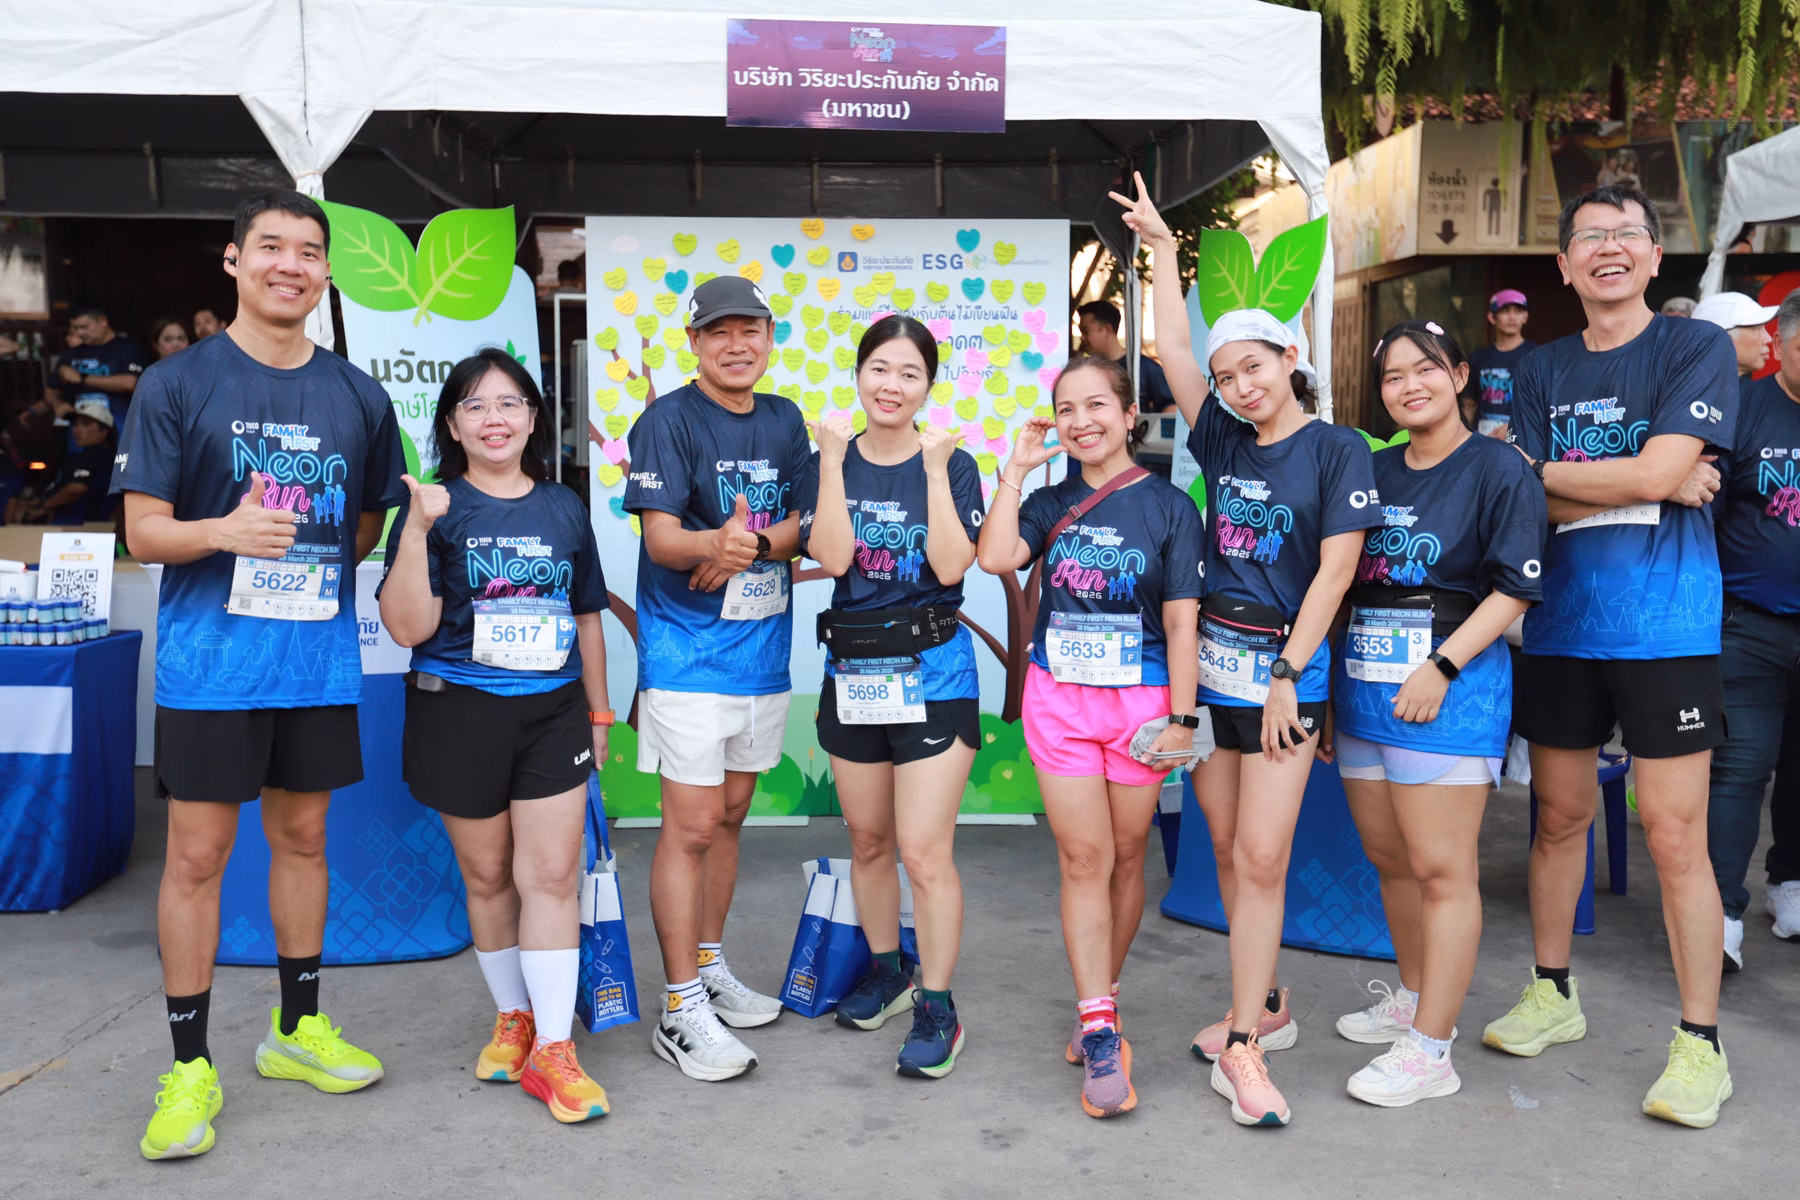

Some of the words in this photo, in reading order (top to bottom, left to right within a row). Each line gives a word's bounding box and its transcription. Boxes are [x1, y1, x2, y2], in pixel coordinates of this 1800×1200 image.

[733, 66, 792, 87] บริษัท
[798, 68, 940, 91] วิริยะประกันภัย
[946, 71, 1000, 92] จำกัด
[822, 98, 910, 120] (มหาชน)
[922, 254, 963, 270] ESG
[281, 437, 321, 451] FIRST
[1216, 514, 1257, 554] Run
[1049, 535, 1145, 574] Neon
[1226, 548, 1250, 559] 2026
[467, 549, 573, 589] Neon
[867, 571, 891, 581] 2026
[252, 571, 307, 591] 5622
[1051, 558, 1106, 596] Run
[324, 588, 333, 597] M
[741, 578, 776, 598] 5629
[1076, 590, 1102, 600] 2026
[538, 598, 555, 606] NEON
[491, 625, 541, 643] 5617
[1223, 629, 1238, 639] FIRST
[1239, 635, 1258, 643] NEON
[563, 639, 569, 647] F
[1060, 640, 1106, 659] 5633
[1353, 635, 1393, 656] 3553
[1128, 654, 1134, 662] F
[1199, 645, 1239, 673] 5643
[1417, 651, 1422, 659] F
[848, 684, 889, 700] 5698
[910, 694, 916, 702] F
[598, 999, 623, 1009] PLASTIC
[598, 1005, 624, 1016] BOTTLES
[169, 1010, 197, 1022] Ari
